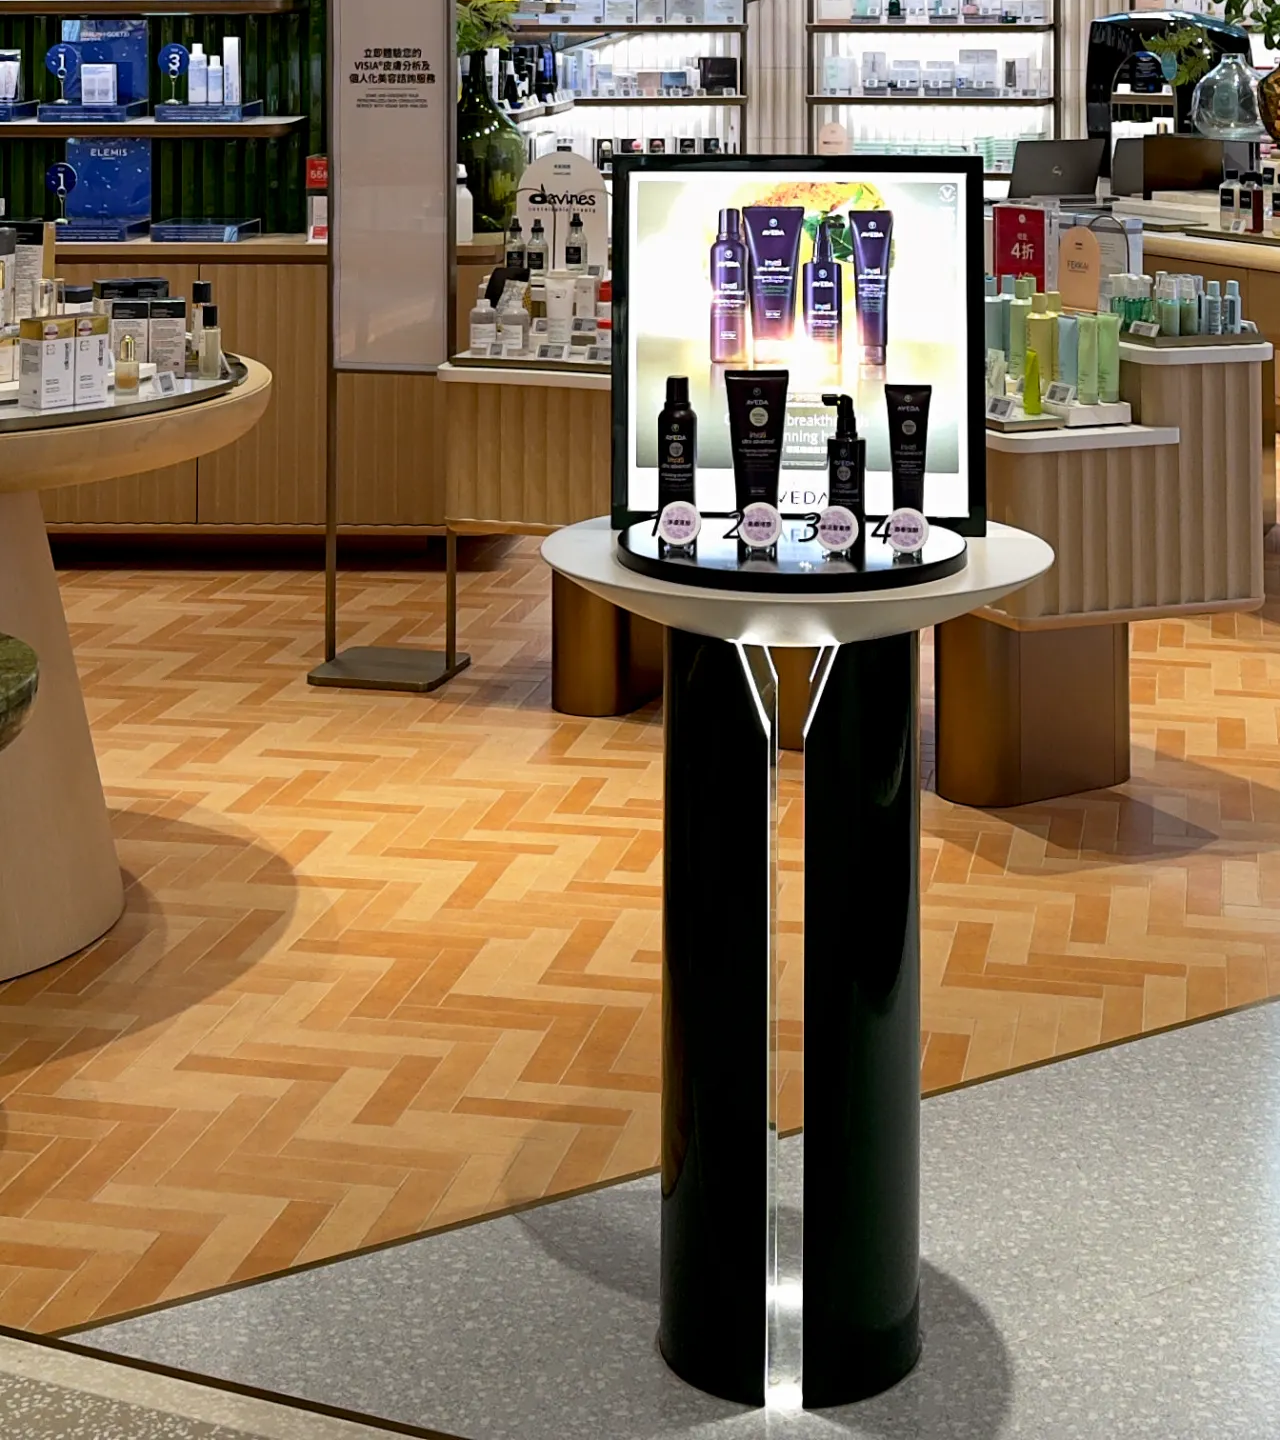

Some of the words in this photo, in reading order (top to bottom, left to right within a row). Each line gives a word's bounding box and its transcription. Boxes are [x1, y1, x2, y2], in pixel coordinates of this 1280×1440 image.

[58, 54, 65, 69] 1
[169, 54, 180, 69] 3
[90, 148, 128, 157] ELEMIS
[58, 173, 66, 189] 1
[528, 182, 596, 206] davines
[1010, 242, 1035, 260] 4折
[722, 509, 746, 540] 2
[798, 512, 821, 543] 3
[871, 514, 892, 544] 4
